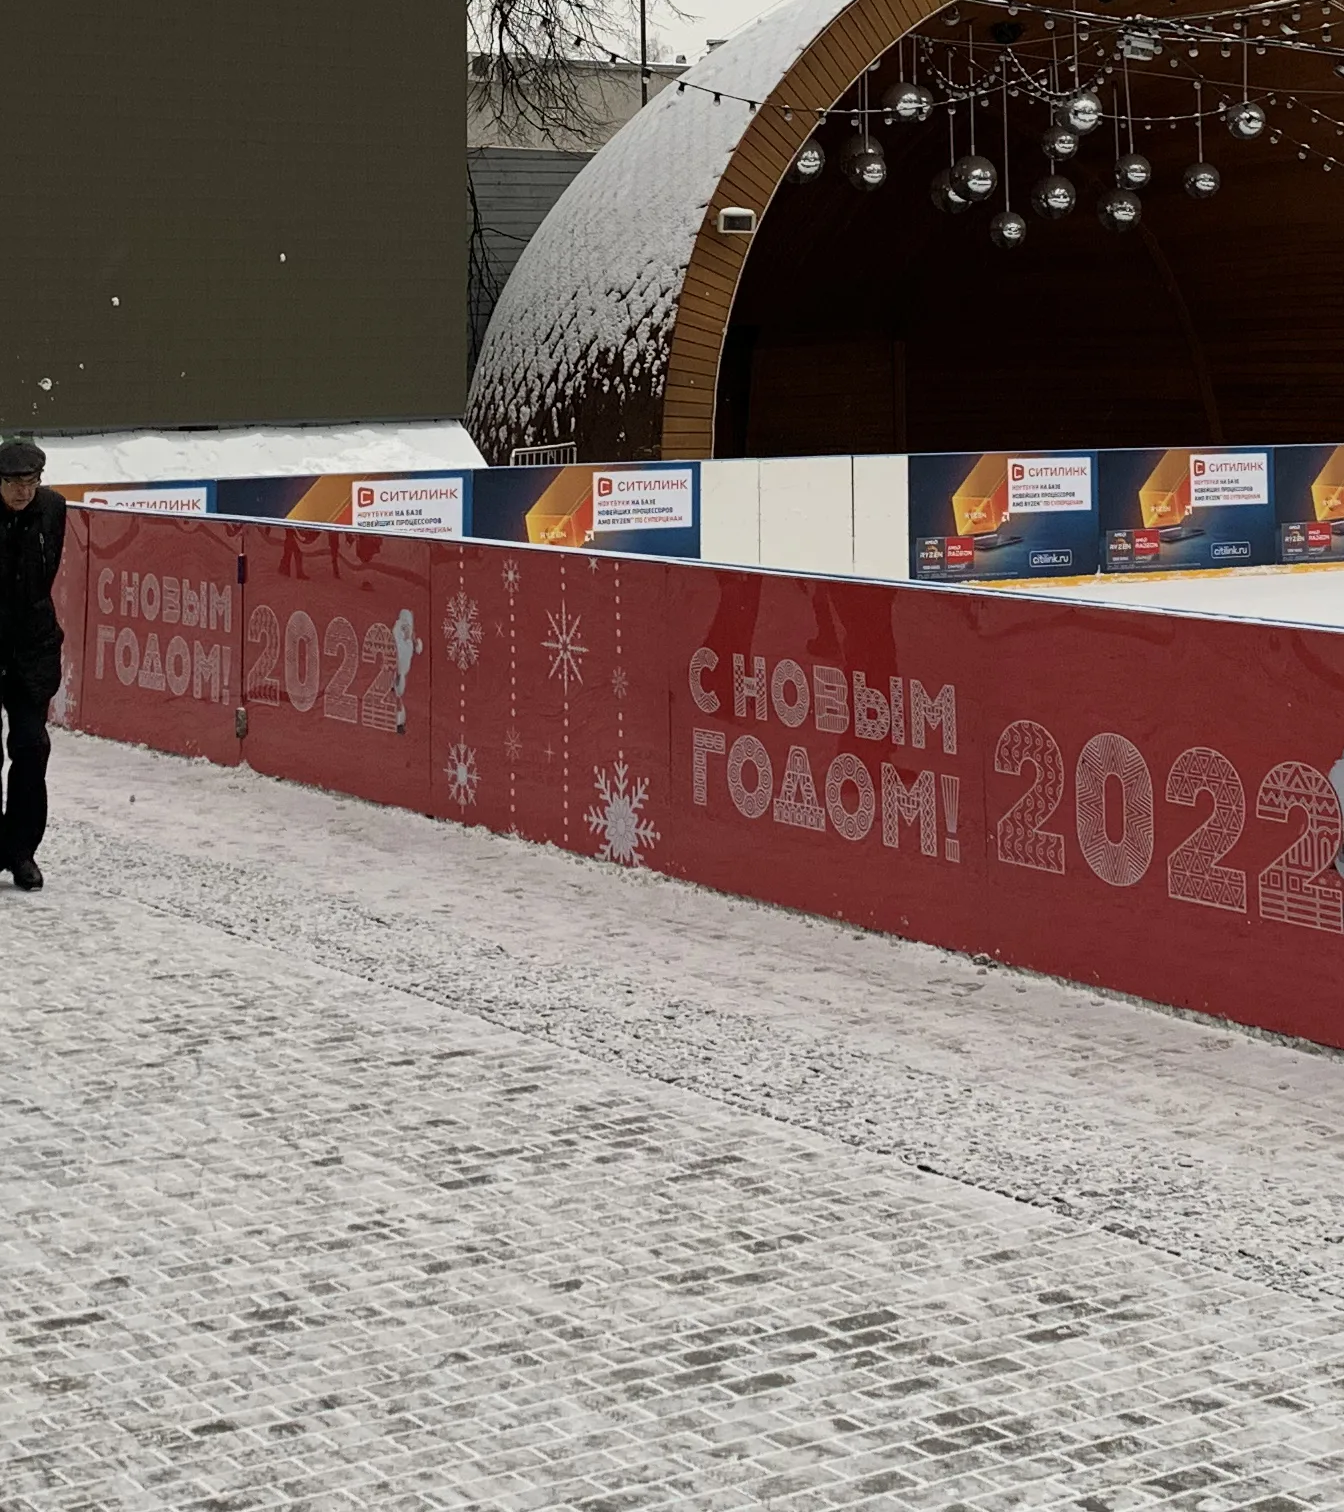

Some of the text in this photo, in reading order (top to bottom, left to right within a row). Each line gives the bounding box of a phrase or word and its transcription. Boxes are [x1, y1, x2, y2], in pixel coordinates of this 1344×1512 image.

[1028, 467, 1087, 477] СИТИЛИНК
[1209, 462, 1264, 472] СИТИЛИНК
[617, 479, 688, 492] СИТИЛИНК
[380, 489, 458, 502] СИТИЛИНК
[358, 510, 394, 518] НОУТБУКИ
[357, 517, 442, 527] НОВЕЙШИХ ПРОЦЕССОРОВ
[97, 567, 232, 633] С НОВЫМ
[95, 625, 231, 706] ГОДОМ!
[247, 605, 398, 733] 2022
[688, 646, 958, 754] С НОВЫМ
[692, 727, 961, 863] ГОДОМ!
